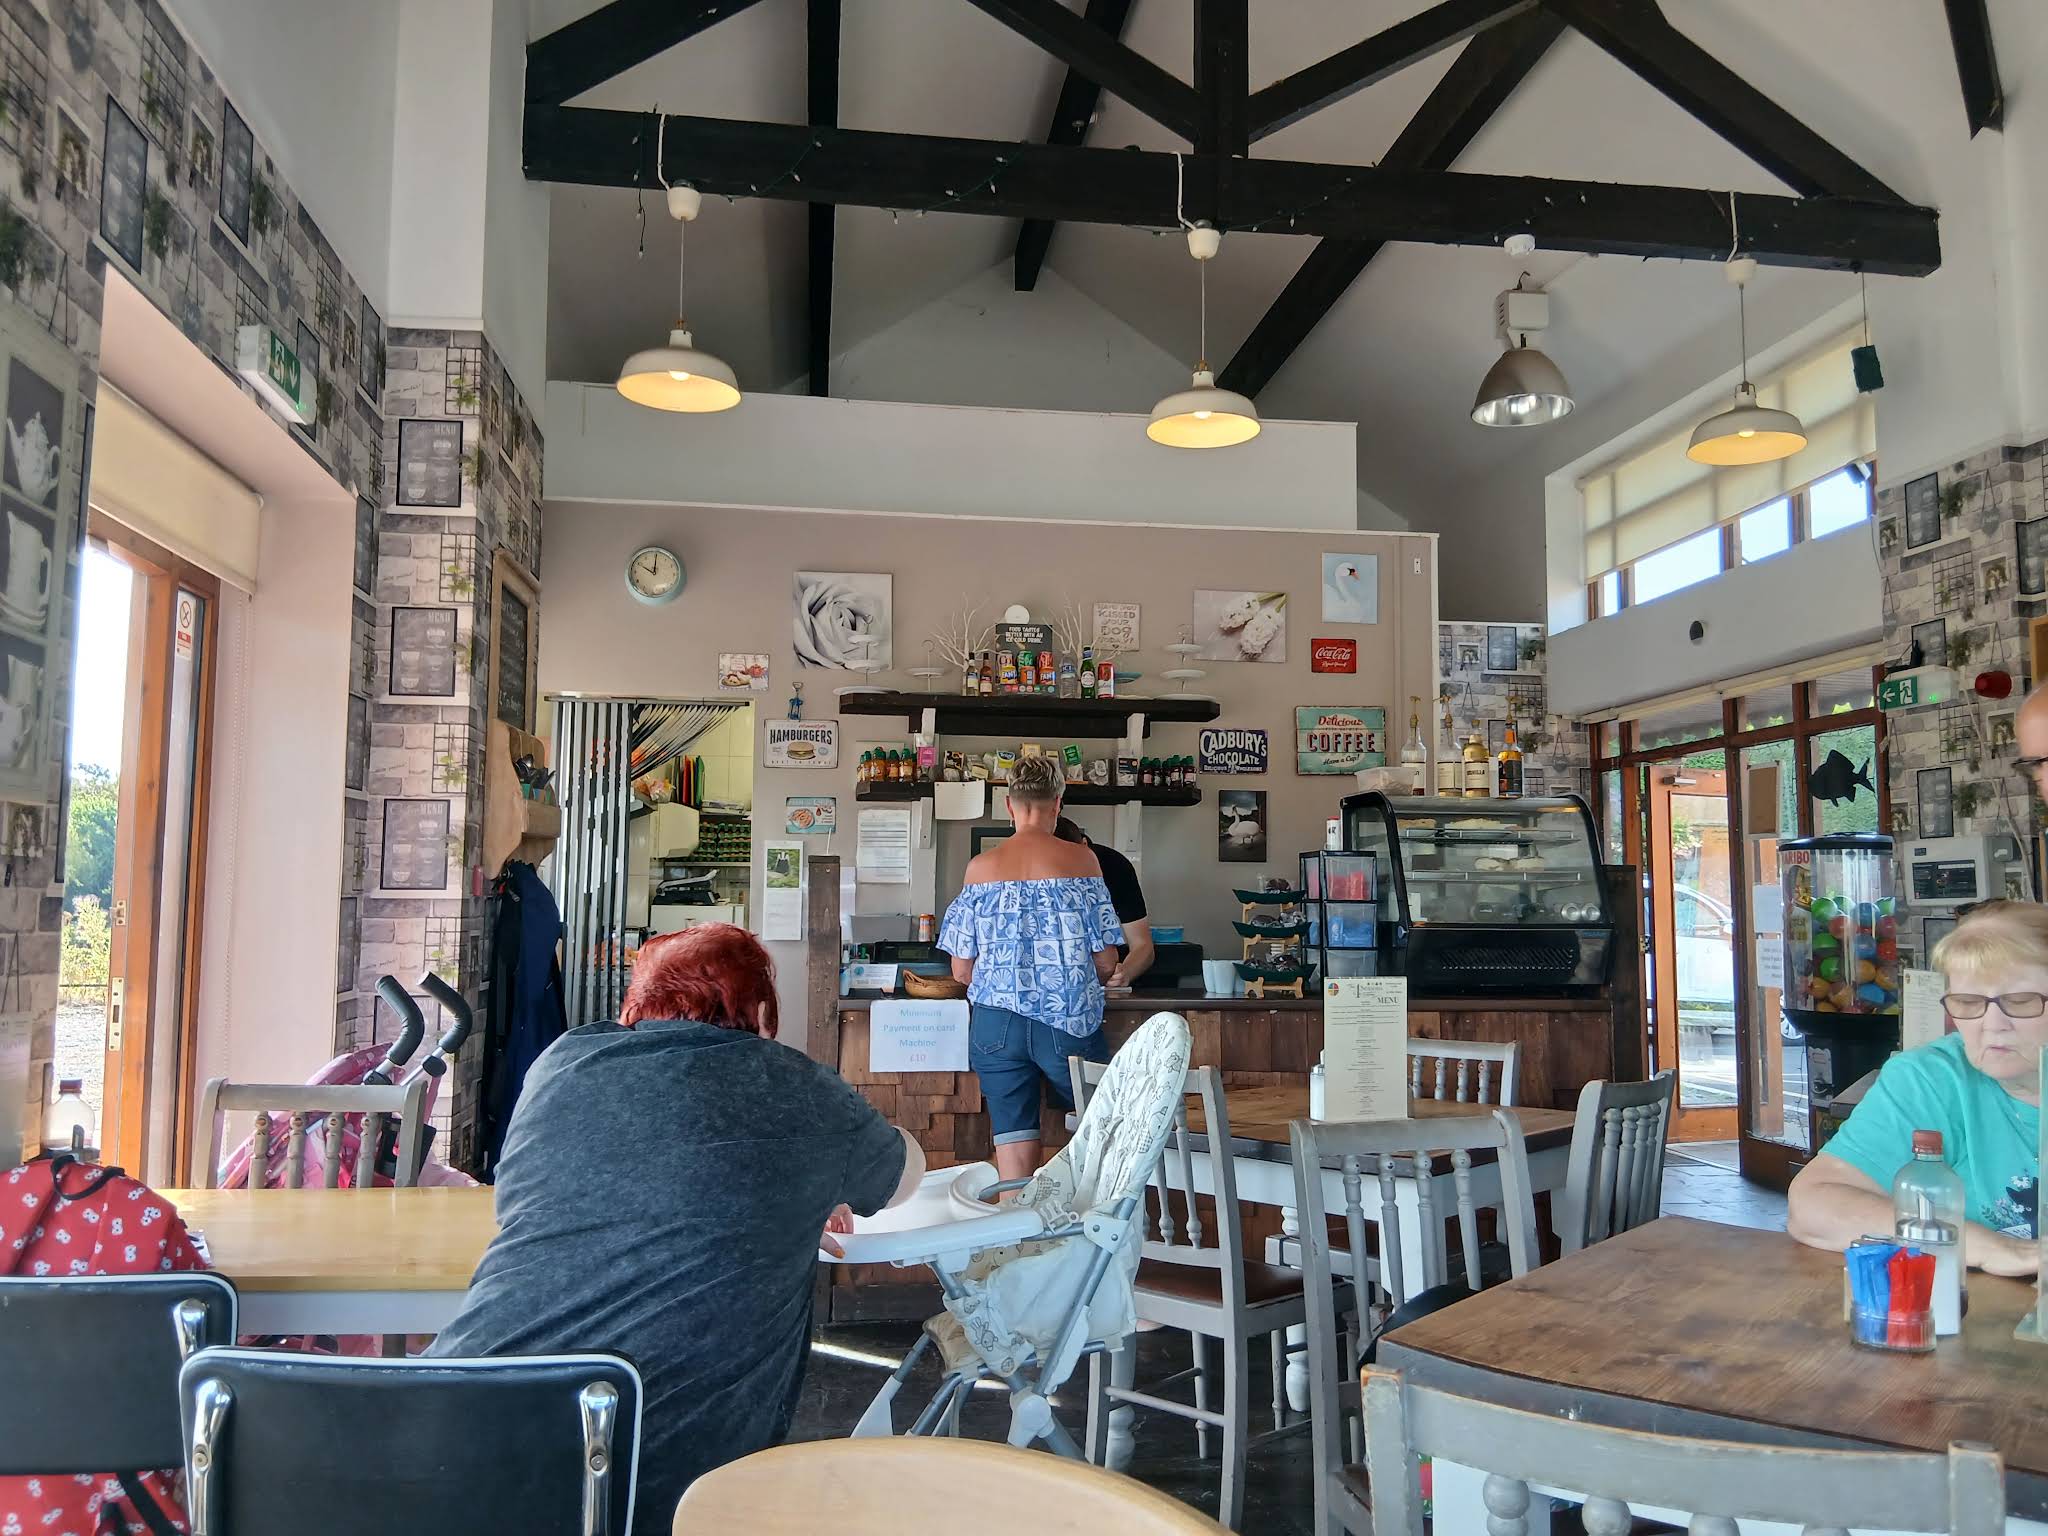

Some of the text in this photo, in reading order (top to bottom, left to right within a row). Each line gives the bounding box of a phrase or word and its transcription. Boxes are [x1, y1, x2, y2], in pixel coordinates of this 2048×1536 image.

[1319, 715, 1363, 726] Delicious
[770, 729, 832, 745] HAMBURGERS
[1307, 732, 1375, 752] COFFEE
[1208, 752, 1260, 765] CHOCOLATE
[1378, 996, 1399, 1004] MENU
[883, 1024, 920, 1034] Payment
[936, 1024, 955, 1032] card
[899, 1039, 937, 1048] Machine
